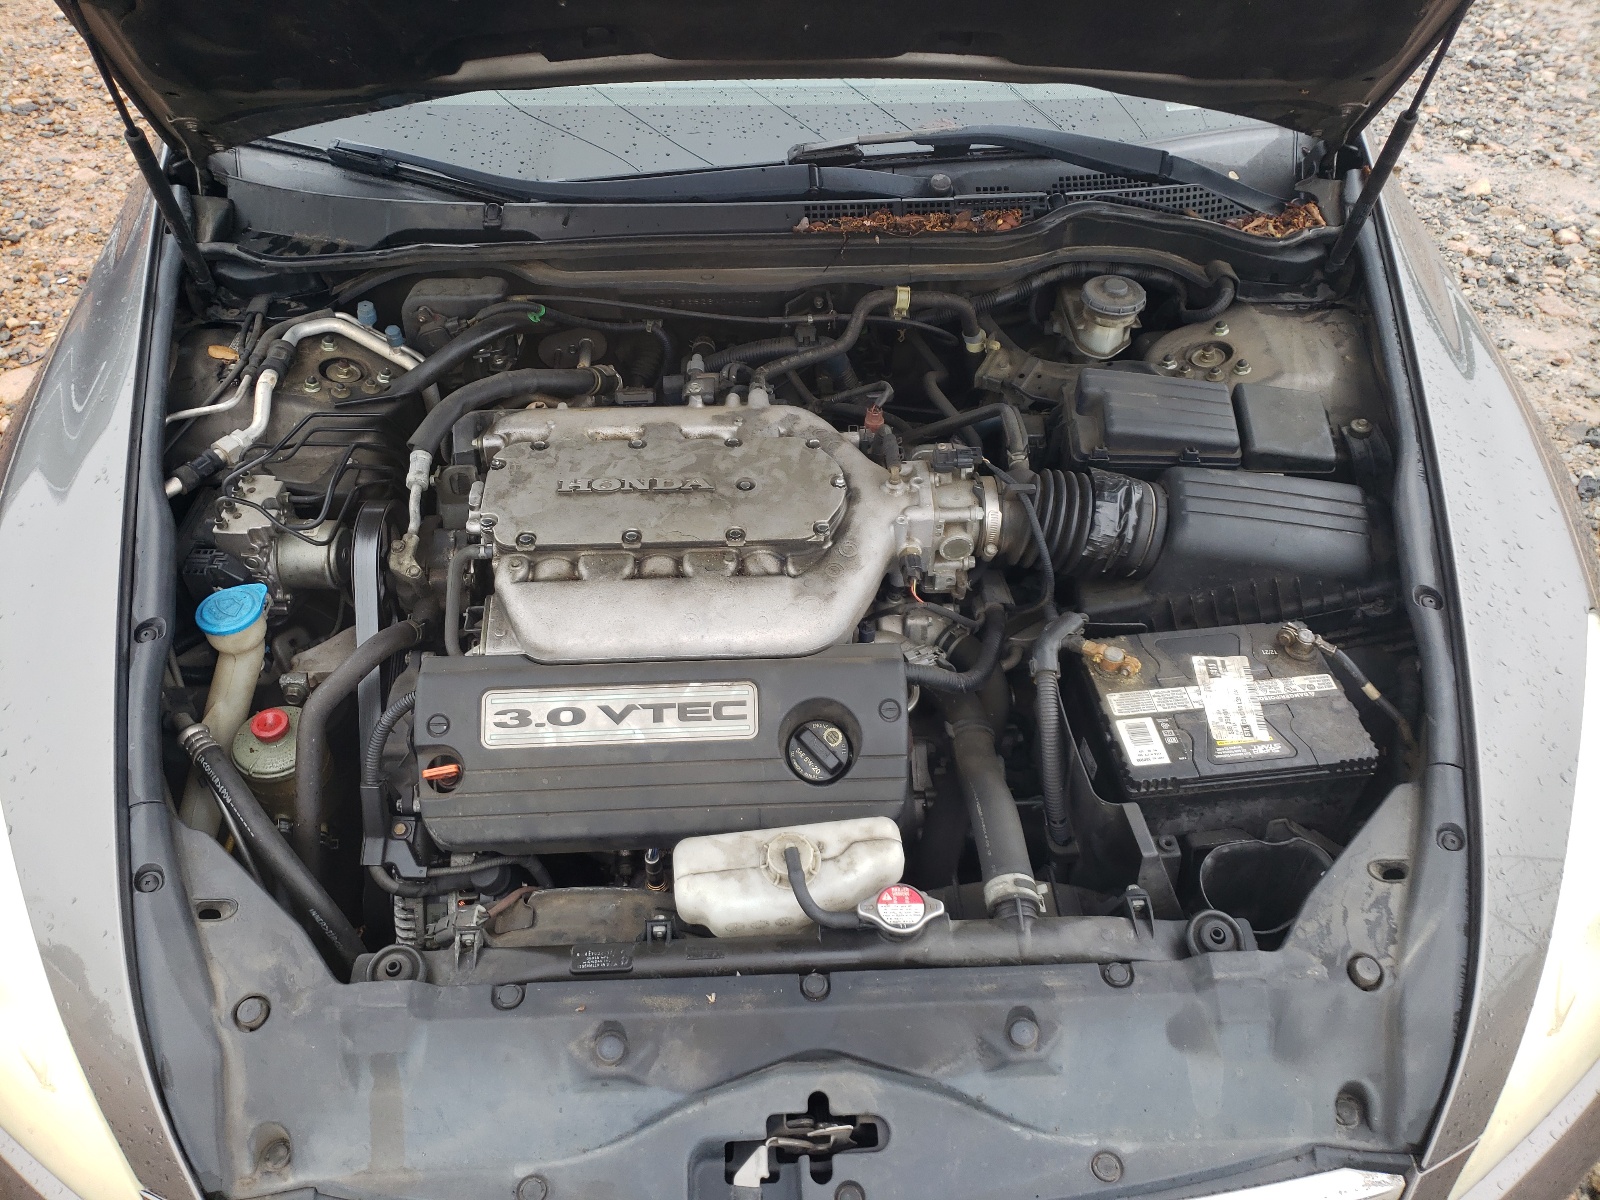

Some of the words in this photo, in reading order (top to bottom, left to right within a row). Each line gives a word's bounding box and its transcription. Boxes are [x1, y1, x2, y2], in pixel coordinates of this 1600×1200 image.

[557, 477, 715, 493] HONDA
[493, 708, 587, 729] 3.0
[597, 700, 747, 726] VTEC
[795, 747, 806, 758] SAE
[803, 756, 820, 774] 5W-20
